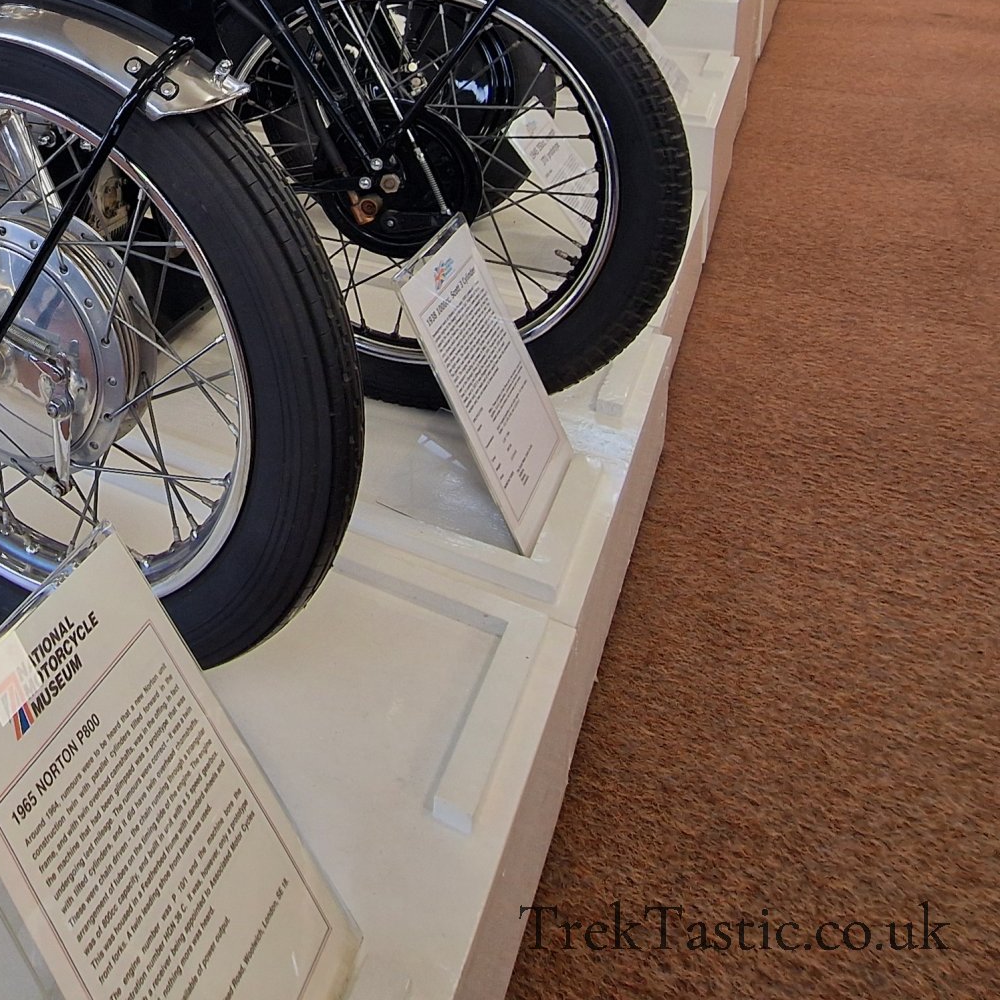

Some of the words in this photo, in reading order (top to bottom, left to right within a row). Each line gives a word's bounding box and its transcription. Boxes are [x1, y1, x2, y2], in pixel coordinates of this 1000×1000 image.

[30, 653, 82, 717] MUSEUM
[11, 790, 37, 825] 1965
[35, 739, 78, 796] NORTON
[75, 713, 99, 745] P800
[24, 817, 46, 847] Around
[45, 800, 61, 819] 1964,
[60, 772, 82, 801] rumours
[81, 756, 94, 773] were
[92, 748, 100, 758] to
[98, 739, 107, 749] be
[106, 720, 121, 740] heard
[119, 708, 131, 723] that
[32, 815, 66, 860] construction
[65, 798, 78, 815] twin
[78, 782, 90, 798] with
[90, 756, 109, 784] parallel
[109, 729, 130, 758] cylinders
[38, 850, 58, 874] frame,
[56, 832, 68, 851] and
[66, 819, 79, 836] with
[77, 805, 89, 822] twin
[88, 774, 111, 807] overhead
[109, 746, 135, 778] camshafts,
[133, 732, 143, 747] was
[146, 717, 155, 728] the
[45, 872, 56, 887] the
[56, 840, 80, 873] machine
[78, 824, 91, 842] that
[89, 809, 101, 827] had
[100, 793, 114, 812] been
[113, 763, 135, 796] glimpsed
[134, 751, 145, 766] was
[148, 718, 168, 748] prototype
[167, 705, 177, 720] that
[176, 695, 185, 708] was
[53, 857, 85, 901] undergoing
[82, 842, 94, 859] test
[93, 817, 114, 845] mileage.
[111, 803, 123, 817] The
[122, 776, 142, 805] rumours
[140, 762, 152, 779] were
[150, 740, 167, 764] correct
[60, 895, 74, 914] with
[73, 873, 88, 897] tilted
[88, 842, 113, 876] cylinders,
[112, 824, 122, 842] and
[126, 805, 135, 821] did
[134, 791, 147, 808] have
[145, 777, 157, 792] twin
[67, 902, 86, 927] These
[84, 883, 99, 904] were
[98, 863, 113, 885] chain
[112, 841, 128, 865] driven
[130, 823, 139, 837] the
[138, 805, 152, 825] chain
[151, 781, 169, 807] running
[76, 892, 109, 942] arrangement
[112, 864, 128, 886] tubes
[132, 842, 143, 856] the
[140, 821, 157, 845] timing
[155, 807, 166, 824] side
[176, 769, 191, 792] engine.
[83, 937, 96, 956] was
[101, 903, 118, 928] 800cc
[117, 872, 140, 905] capacity,
[138, 855, 148, 873] and
[146, 839, 159, 858] built
[172, 803, 183, 820] with
[90, 949, 104, 970] This
[102, 933, 115, 951] was
[113, 902, 133, 935] housed
[140, 850, 166, 892] Featherbed
[186, 790, 205, 820] standard
[98, 960, 113, 985] front
[111, 940, 127, 964] forks.
[126, 930, 132, 941] A
[130, 914, 143, 933] twin
[140, 887, 160, 916] leading
[158, 869, 171, 889] shoe
[168, 851, 181, 871] front
[179, 833, 193, 855] brake
[191, 820, 201, 835] was
[199, 803, 212, 822] used.
[122, 955, 140, 985] engine
[141, 922, 160, 954] number
[161, 903, 172, 921] was
[188, 858, 198, 876] and
[197, 845, 206, 860] the
[206, 817, 224, 845] machine
[222, 800, 234, 816] bore
[233, 787, 241, 800] the
[146, 939, 164, 972] number
[162, 920, 176, 942] HGN
[229, 798, 248, 831] prototype
[152, 954, 171, 990] receiver
[169, 932, 185, 956] being
[184, 894, 206, 934] appointed
[203, 887, 211, 897] to
[209, 849, 232, 889] Associated
[229, 830, 242, 852] Motor
[240, 810, 255, 832] Cycles
[275, 885, 283, 900] SE
[162, 964, 182, 997] nothing
[180, 944, 193, 967] more
[191, 928, 202, 946] was
[199, 905, 214, 930] heard.
[196, 962, 203, 976] of
[201, 940, 216, 969] power
[214, 915, 230, 943] output.
